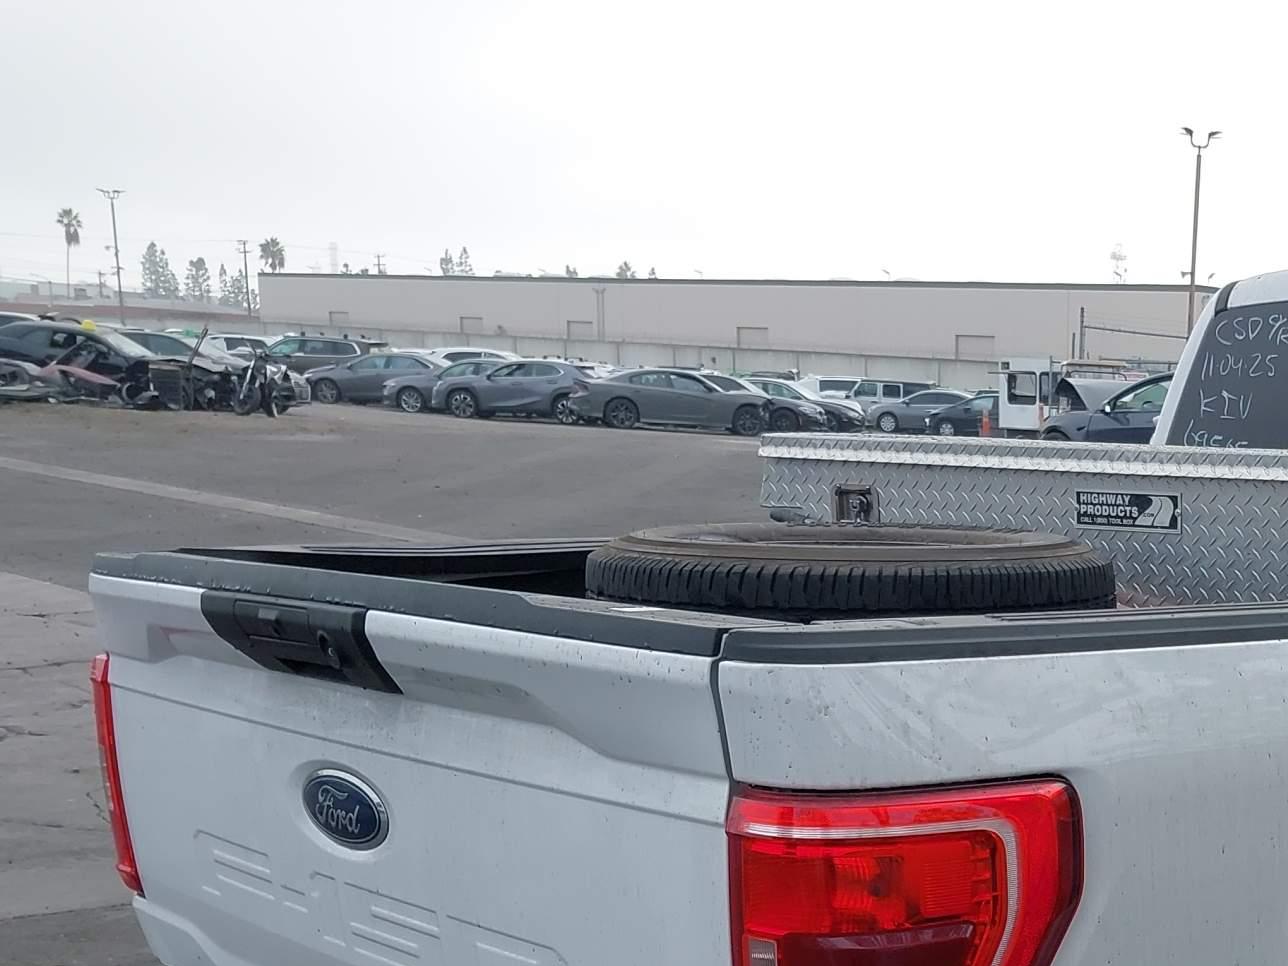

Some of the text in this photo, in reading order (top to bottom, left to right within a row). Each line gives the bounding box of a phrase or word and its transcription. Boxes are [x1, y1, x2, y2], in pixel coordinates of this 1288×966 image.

[1199, 388, 1253, 419] KIV
[1079, 493, 1131, 505] HIGHWAY
[1080, 504, 1139, 518] PRODUCTS
[315, 784, 361, 834] Ford
